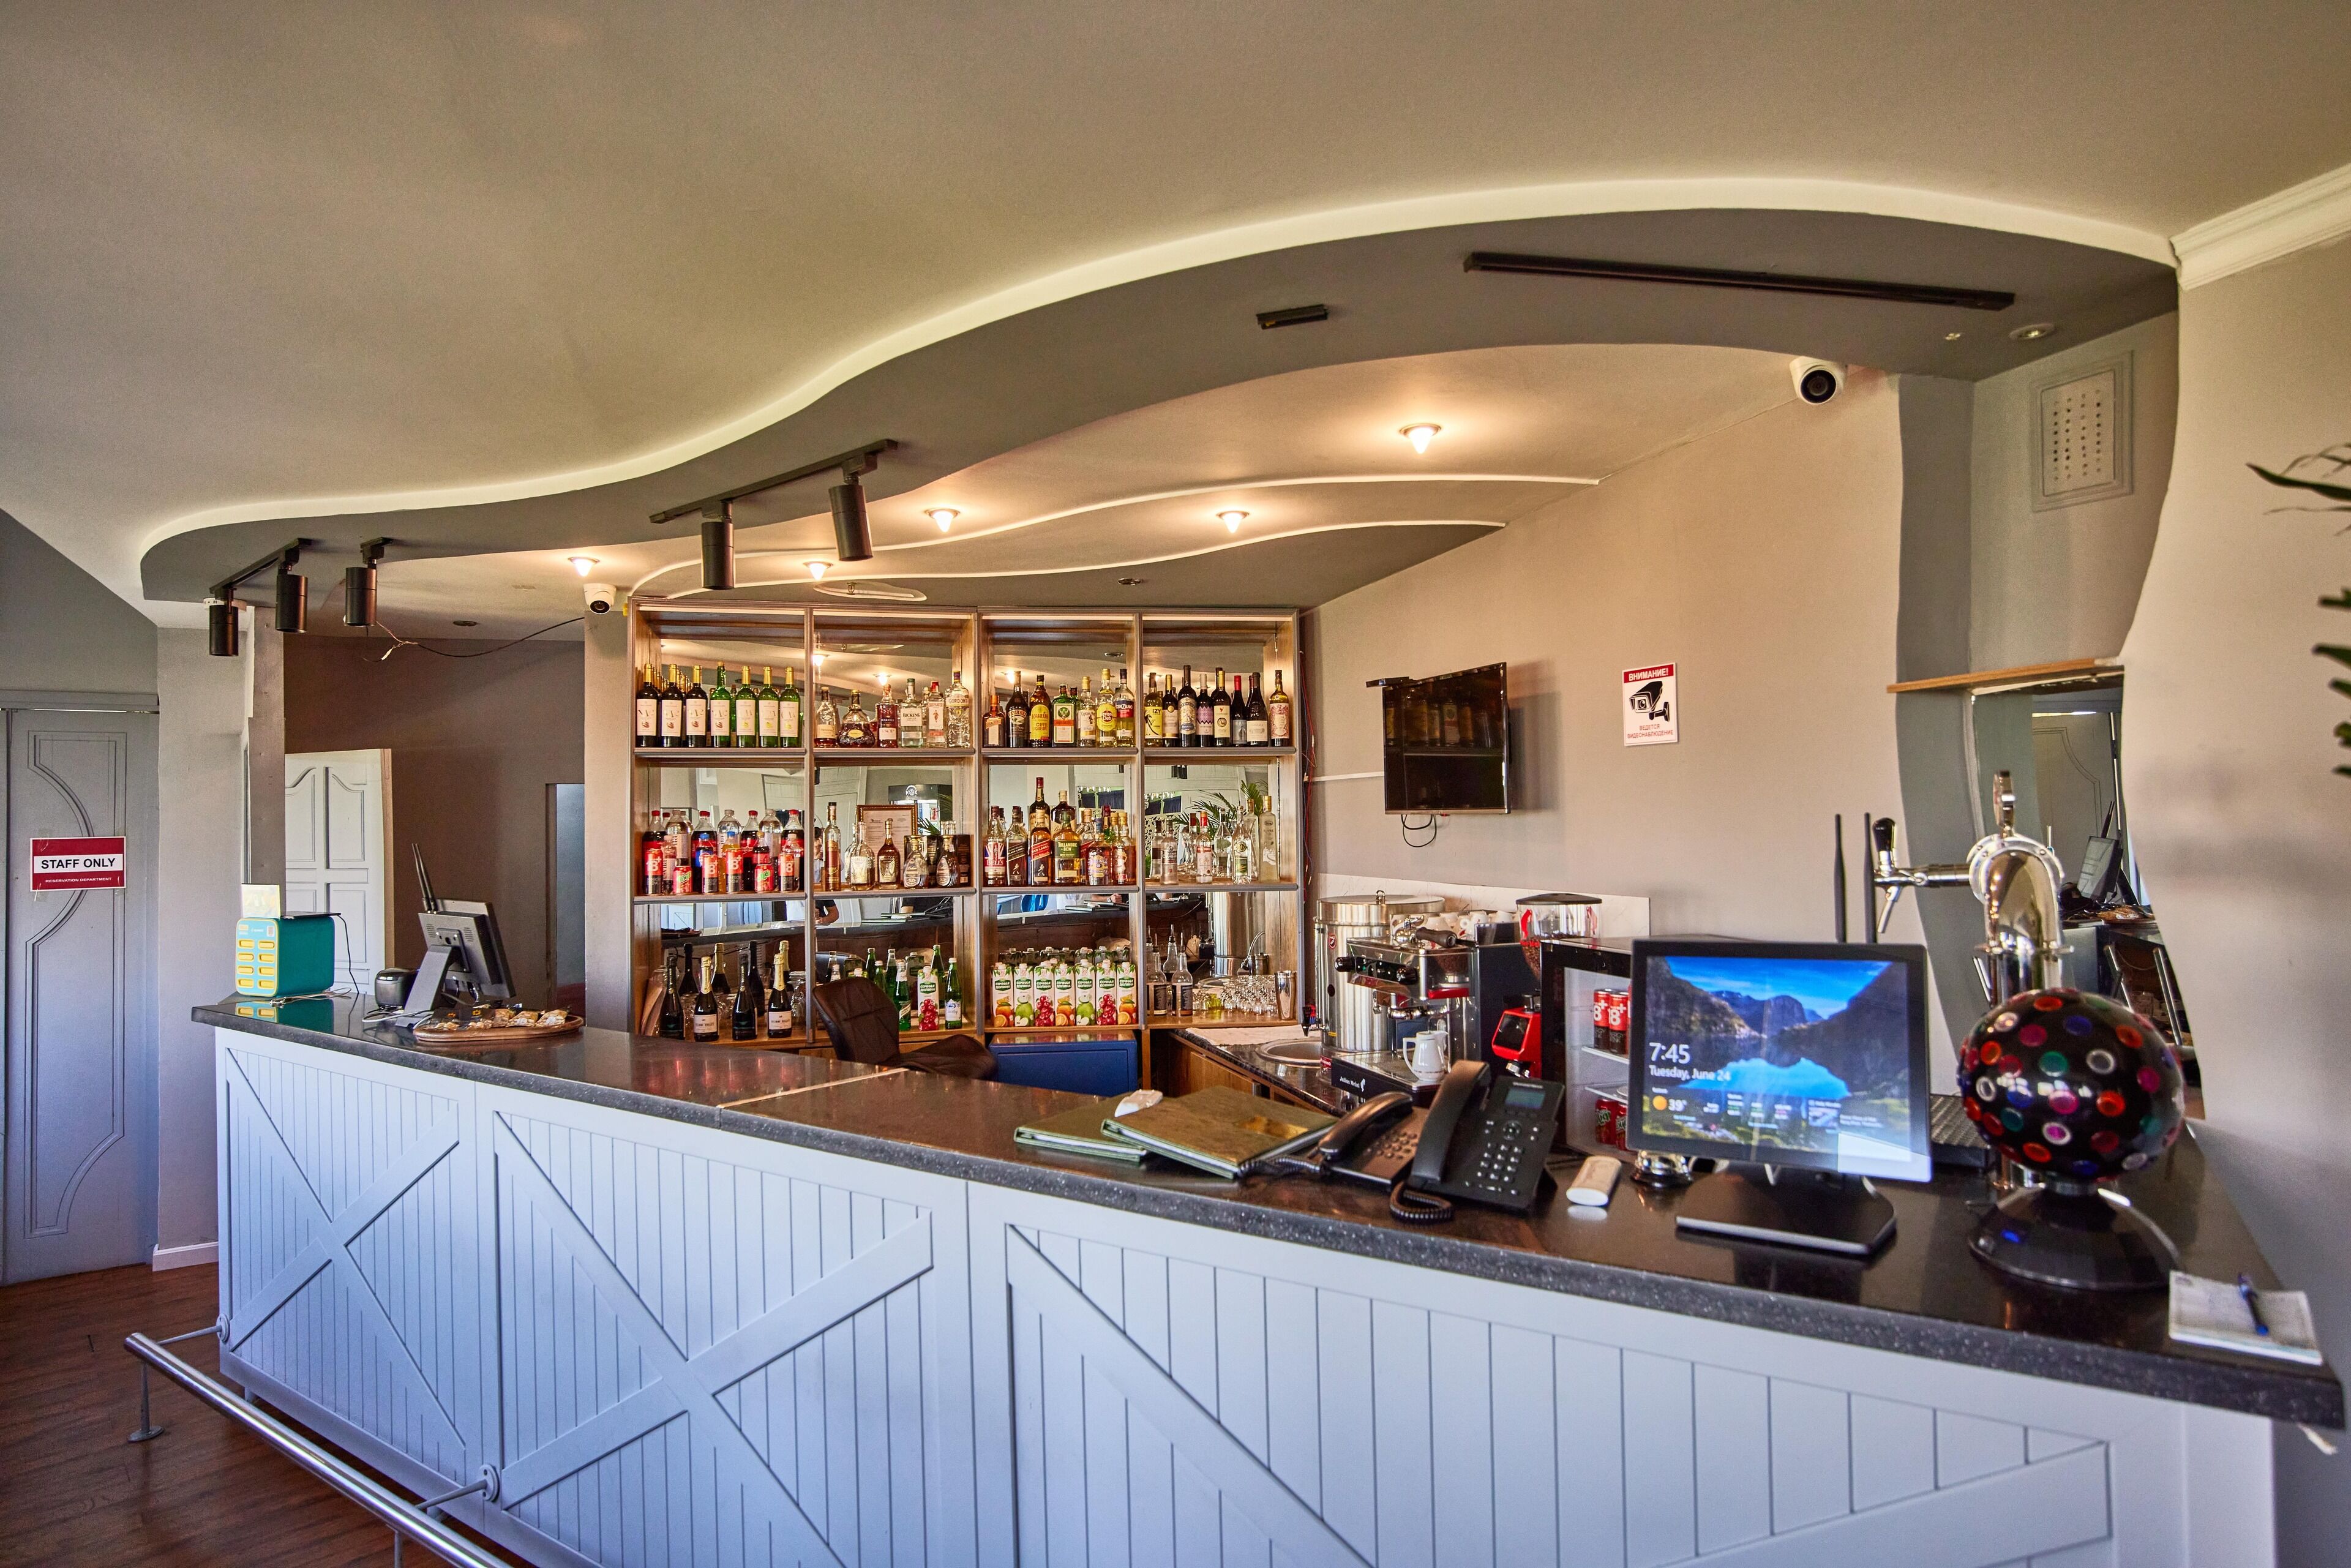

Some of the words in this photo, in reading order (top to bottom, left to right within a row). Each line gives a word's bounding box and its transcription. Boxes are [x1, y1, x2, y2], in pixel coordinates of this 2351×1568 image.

[1629, 667, 1668, 681] ВНИМАНИЕ!
[1627, 730, 1673, 738] ВИДЕОНАБЛЮДЕНИЕ
[41, 860, 80, 869] STAFF
[83, 858, 115, 868] ONLY
[1649, 1042, 1690, 1064] 7:45
[1648, 1065, 1690, 1081] Tuesday,
[1692, 1068, 1715, 1081] June
[1716, 1069, 1731, 1081] 24
